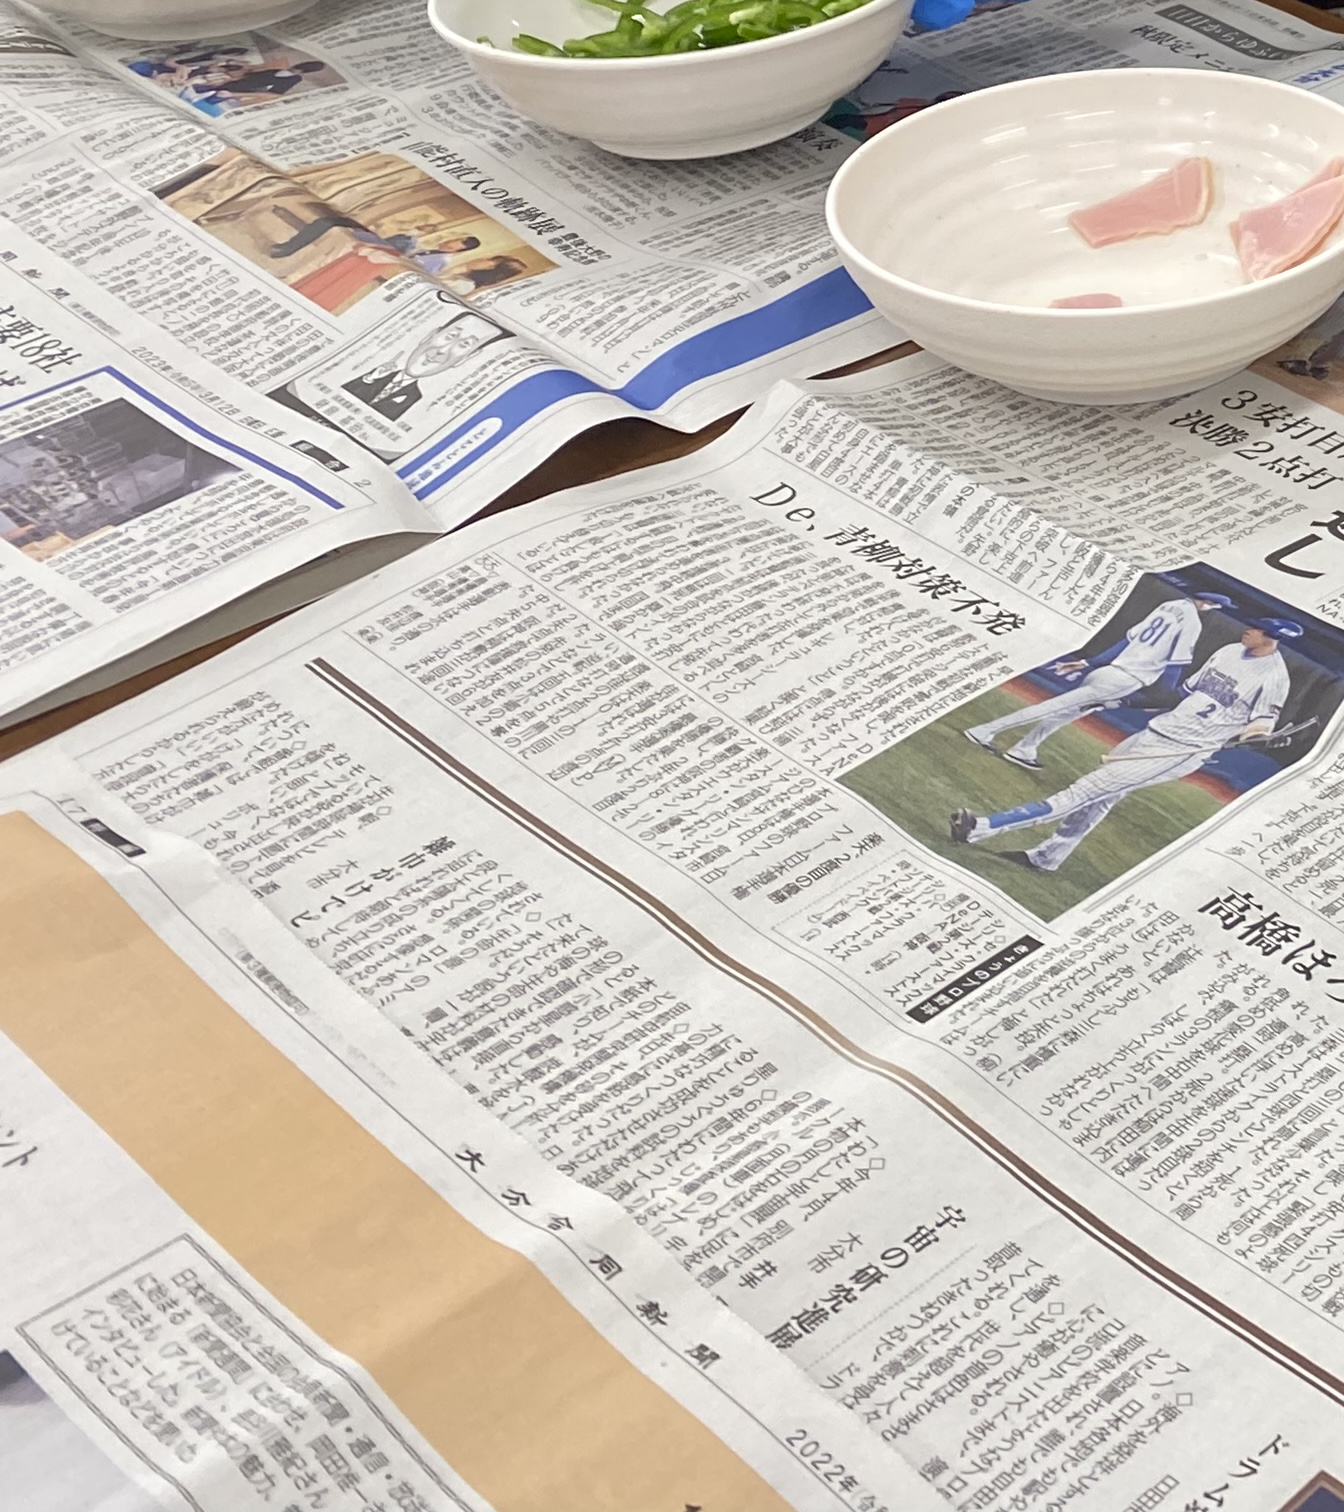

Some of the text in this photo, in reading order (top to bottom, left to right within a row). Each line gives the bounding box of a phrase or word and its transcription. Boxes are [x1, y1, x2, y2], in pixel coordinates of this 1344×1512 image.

[1168, 408, 1344, 491] 決勝2点打
[752, 479, 1029, 639] De、青柳対策不発
[1141, 618, 1172, 647] 81
